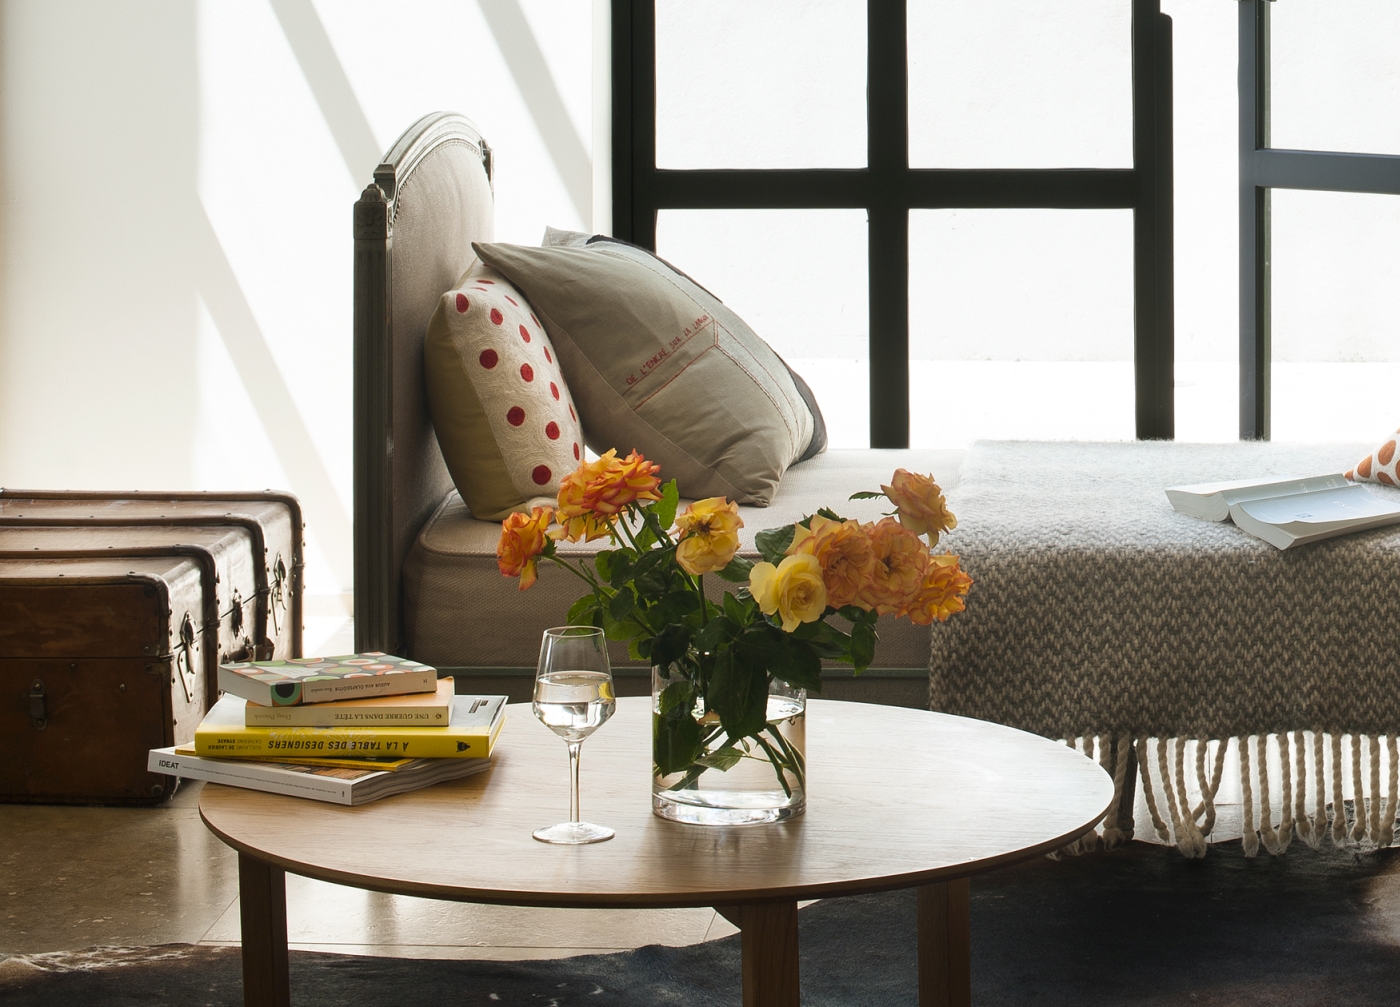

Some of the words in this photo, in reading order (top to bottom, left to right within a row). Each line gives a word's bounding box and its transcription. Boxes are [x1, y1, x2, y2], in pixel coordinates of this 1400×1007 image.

[626, 374, 638, 386] DE
[669, 335, 682, 349] SUR
[683, 327, 692, 338] LA
[253, 712, 276, 721] Peacock
[276, 712, 292, 721] Doug
[334, 713, 354, 722] TÊTE
[267, 740, 325, 749] DESIGNERS
[327, 741, 348, 750] DES
[351, 741, 382, 750] TABLE
[386, 741, 399, 750] LA
[402, 741, 410, 752] À
[158, 759, 180, 770] IDEAT
